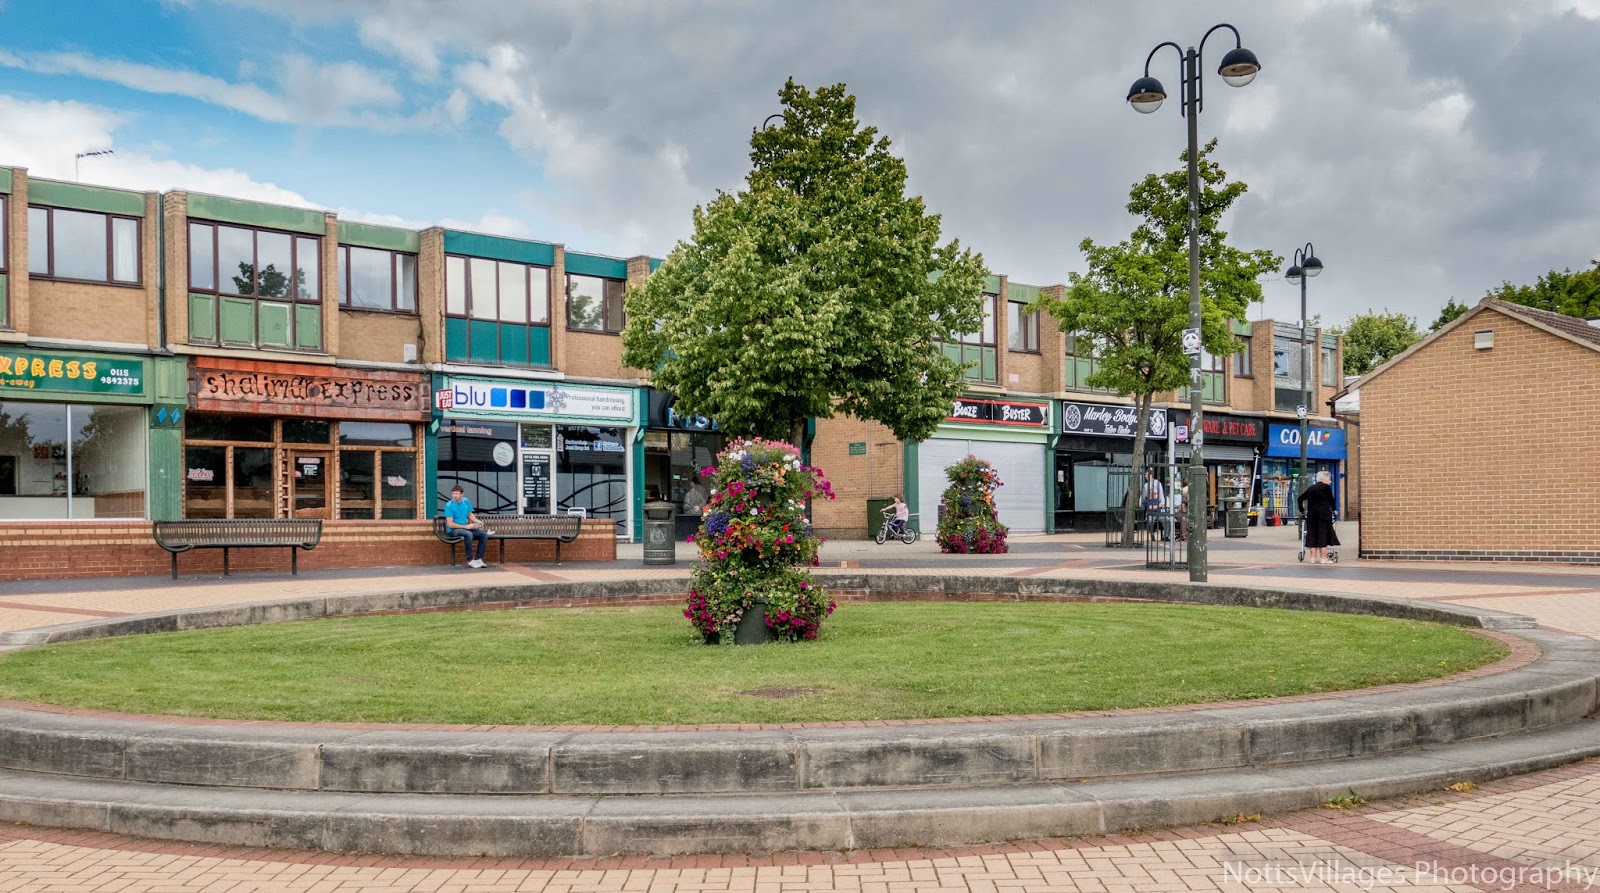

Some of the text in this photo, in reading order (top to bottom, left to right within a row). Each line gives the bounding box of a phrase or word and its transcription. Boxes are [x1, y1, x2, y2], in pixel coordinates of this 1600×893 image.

[110, 368, 129, 376] 0115
[100, 377, 139, 386] 9892375
[439, 390, 453, 400] JUST
[455, 385, 486, 406] blu
[442, 399, 453, 408] EAT
[1083, 407, 1113, 424] Marley
[466, 427, 492, 436] tanning
[1185, 418, 1220, 434] HWARE
[1222, 422, 1228, 435] &
[1229, 422, 1240, 435] PET
[1241, 424, 1256, 436] CARE
[1280, 428, 1323, 446] COAL
